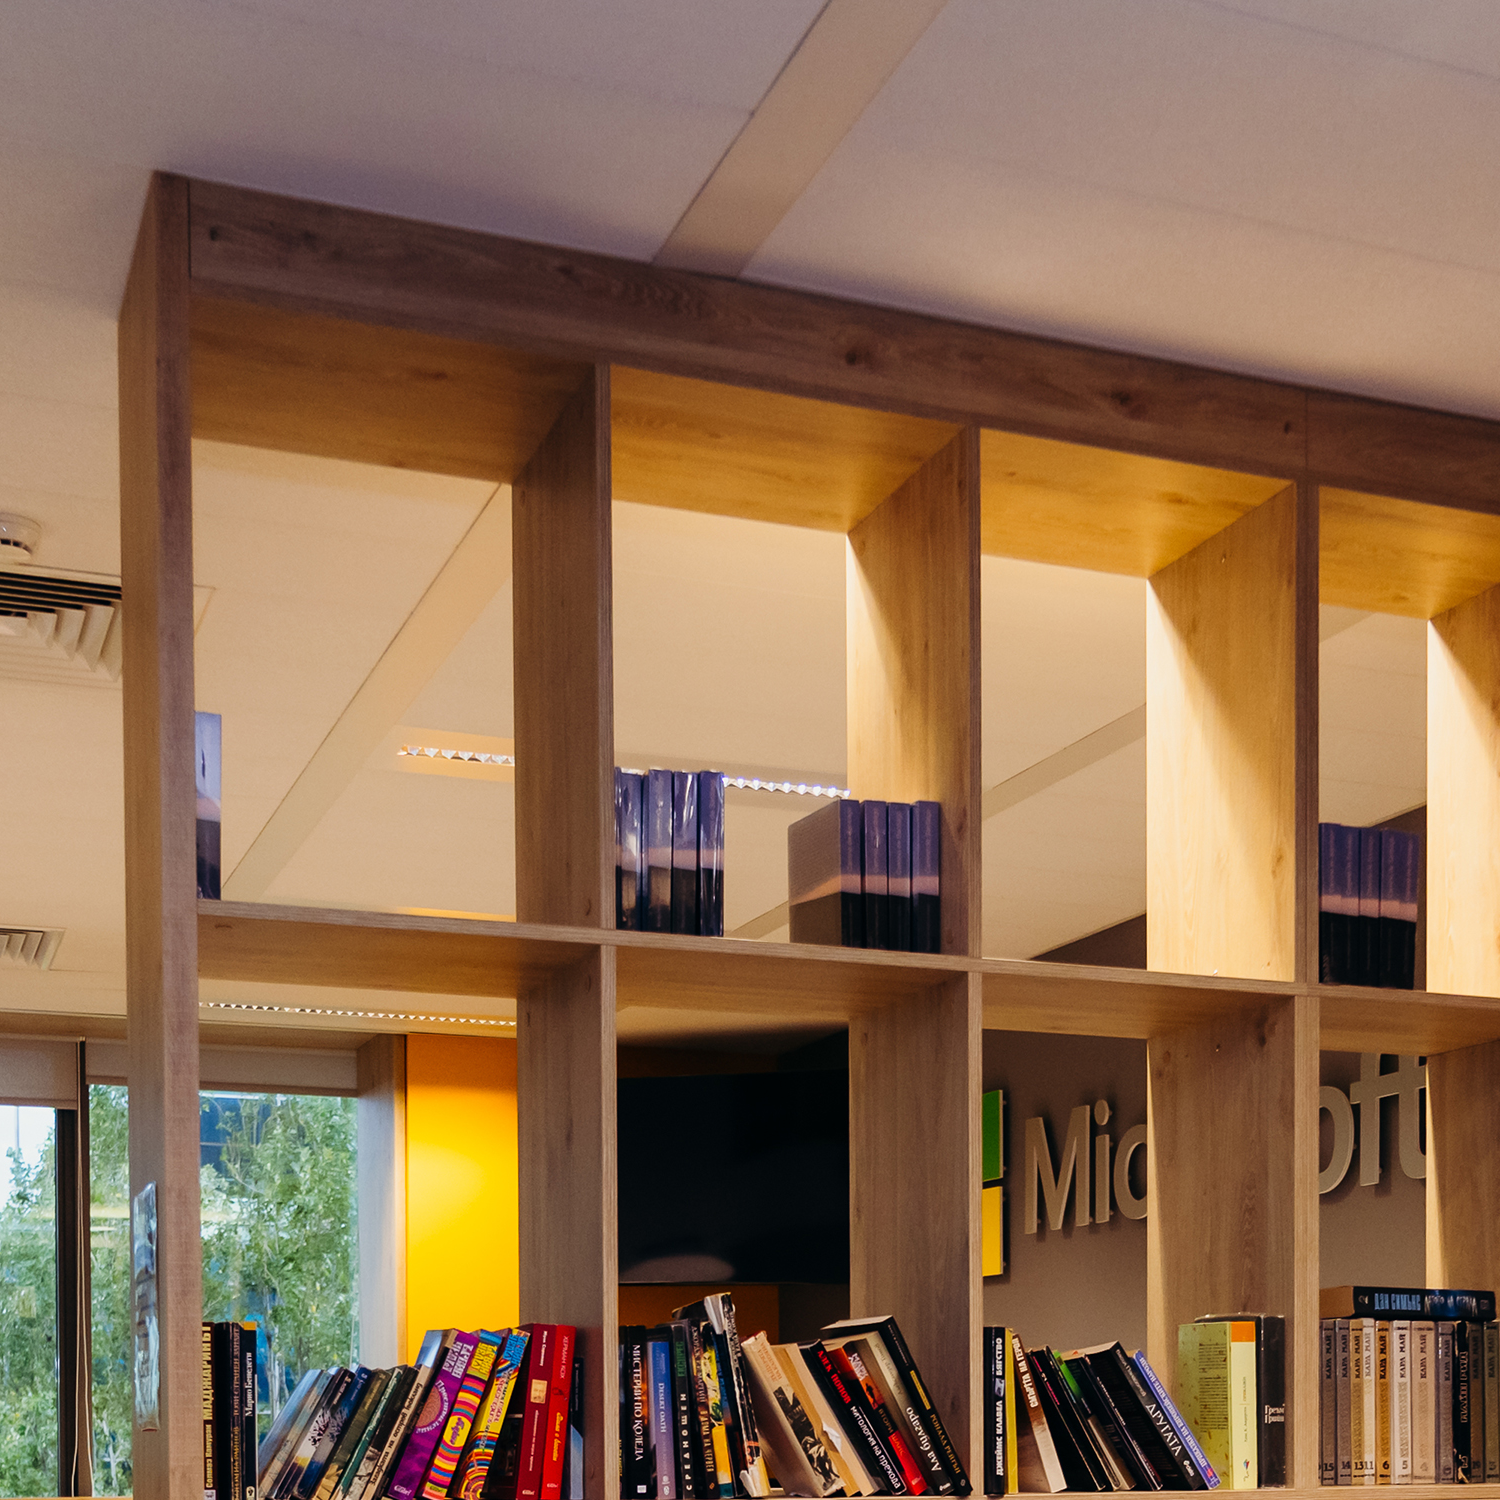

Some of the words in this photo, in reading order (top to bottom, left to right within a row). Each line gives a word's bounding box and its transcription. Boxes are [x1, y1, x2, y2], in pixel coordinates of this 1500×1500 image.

[1374, 1293, 1389, 1310] ДАН
[1391, 1293, 1421, 1311] СИМЪНС
[559, 1334, 570, 1364] ХЕРМАН
[995, 1337, 1003, 1377] БЯГСТВО
[1009, 1336, 1025, 1361] ГЕРОЯ
[558, 1364, 567, 1379] КОХ
[632, 1344, 642, 1401] МИСТЕРИИ
[817, 1350, 832, 1373] АЛЕК
[831, 1372, 852, 1404] ПОПОВ
[1016, 1359, 1028, 1372] НА
[244, 1388, 253, 1417] Марио
[1019, 1372, 1039, 1408] СМЪРТТА
[633, 1401, 642, 1418] ПО
[995, 1399, 1003, 1434] КЛАВЕЛ
[632, 1420, 644, 1462] КОЛЕДА
[680, 1393, 693, 1491] СРЕДНОЩЕН
[906, 1406, 931, 1451] булгаро
[1145, 1403, 1182, 1456] ДРУГАТА
[927, 1450, 941, 1472] Ала
[994, 1434, 1004, 1476] ДЖЕЙМС
[1323, 1461, 1334, 1471] 15
[1341, 1460, 1350, 1469] 14
[1354, 1461, 1363, 1470] 13
[1364, 1461, 1373, 1470] 11
[1382, 1461, 1389, 1470] 6
[1402, 1460, 1408, 1470] 5
